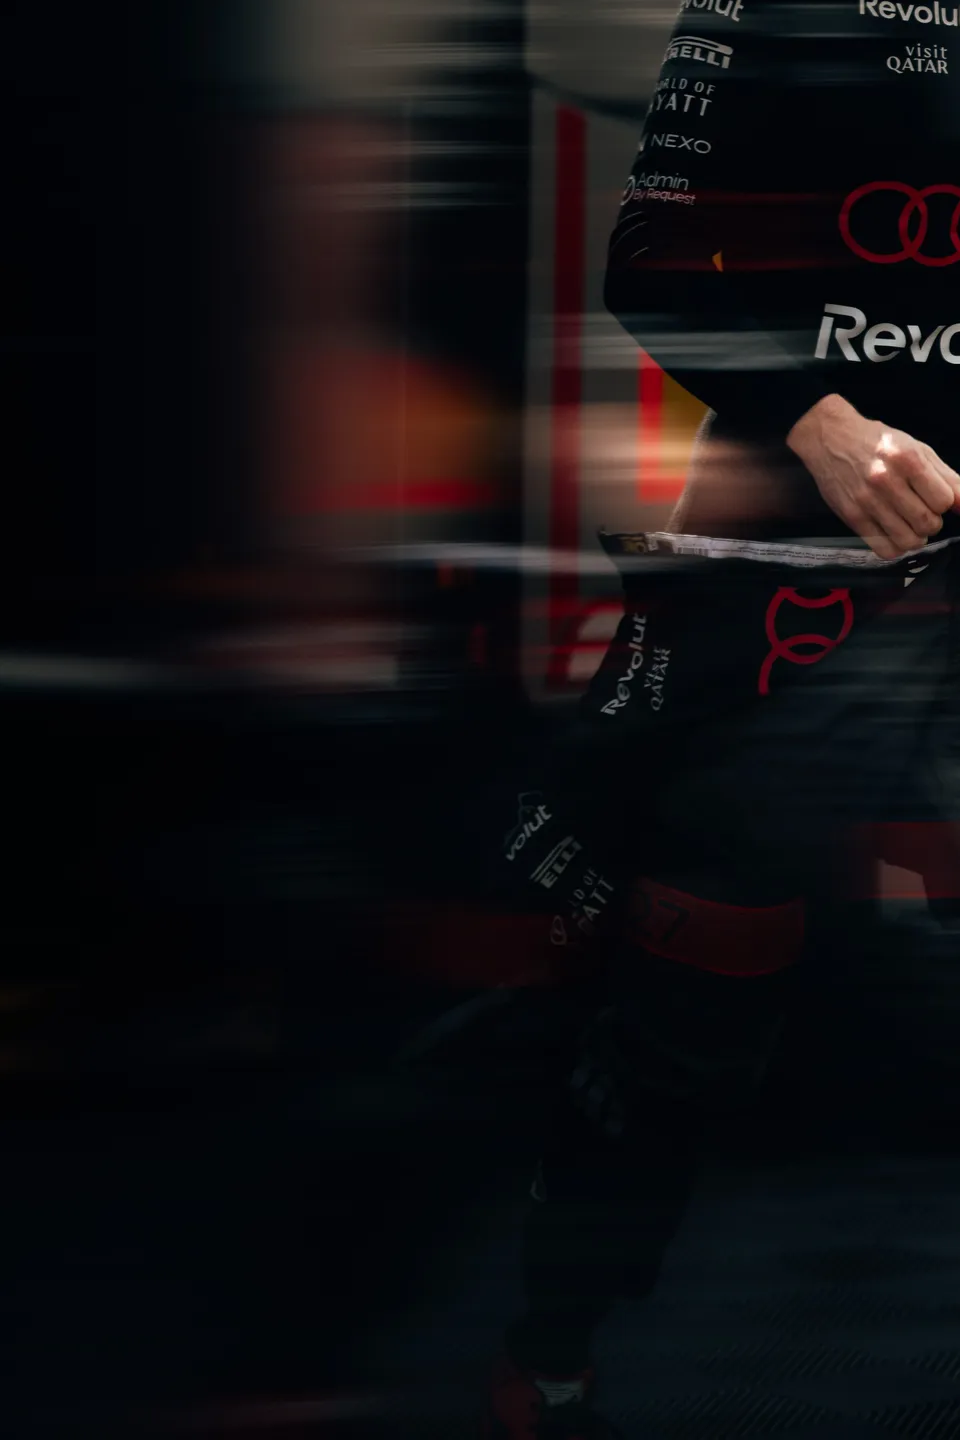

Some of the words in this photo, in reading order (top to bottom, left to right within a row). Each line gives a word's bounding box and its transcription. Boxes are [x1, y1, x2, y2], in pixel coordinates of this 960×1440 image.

[905, 42, 948, 59] visit
[886, 56, 948, 74] QATAR
[694, 81, 716, 95] OF
[649, 92, 712, 116] YATT
[651, 133, 711, 153] NEXO
[636, 171, 689, 191] Admin
[646, 188, 696, 205] Request
[600, 612, 647, 716] Revolut
[505, 804, 552, 861] volut
